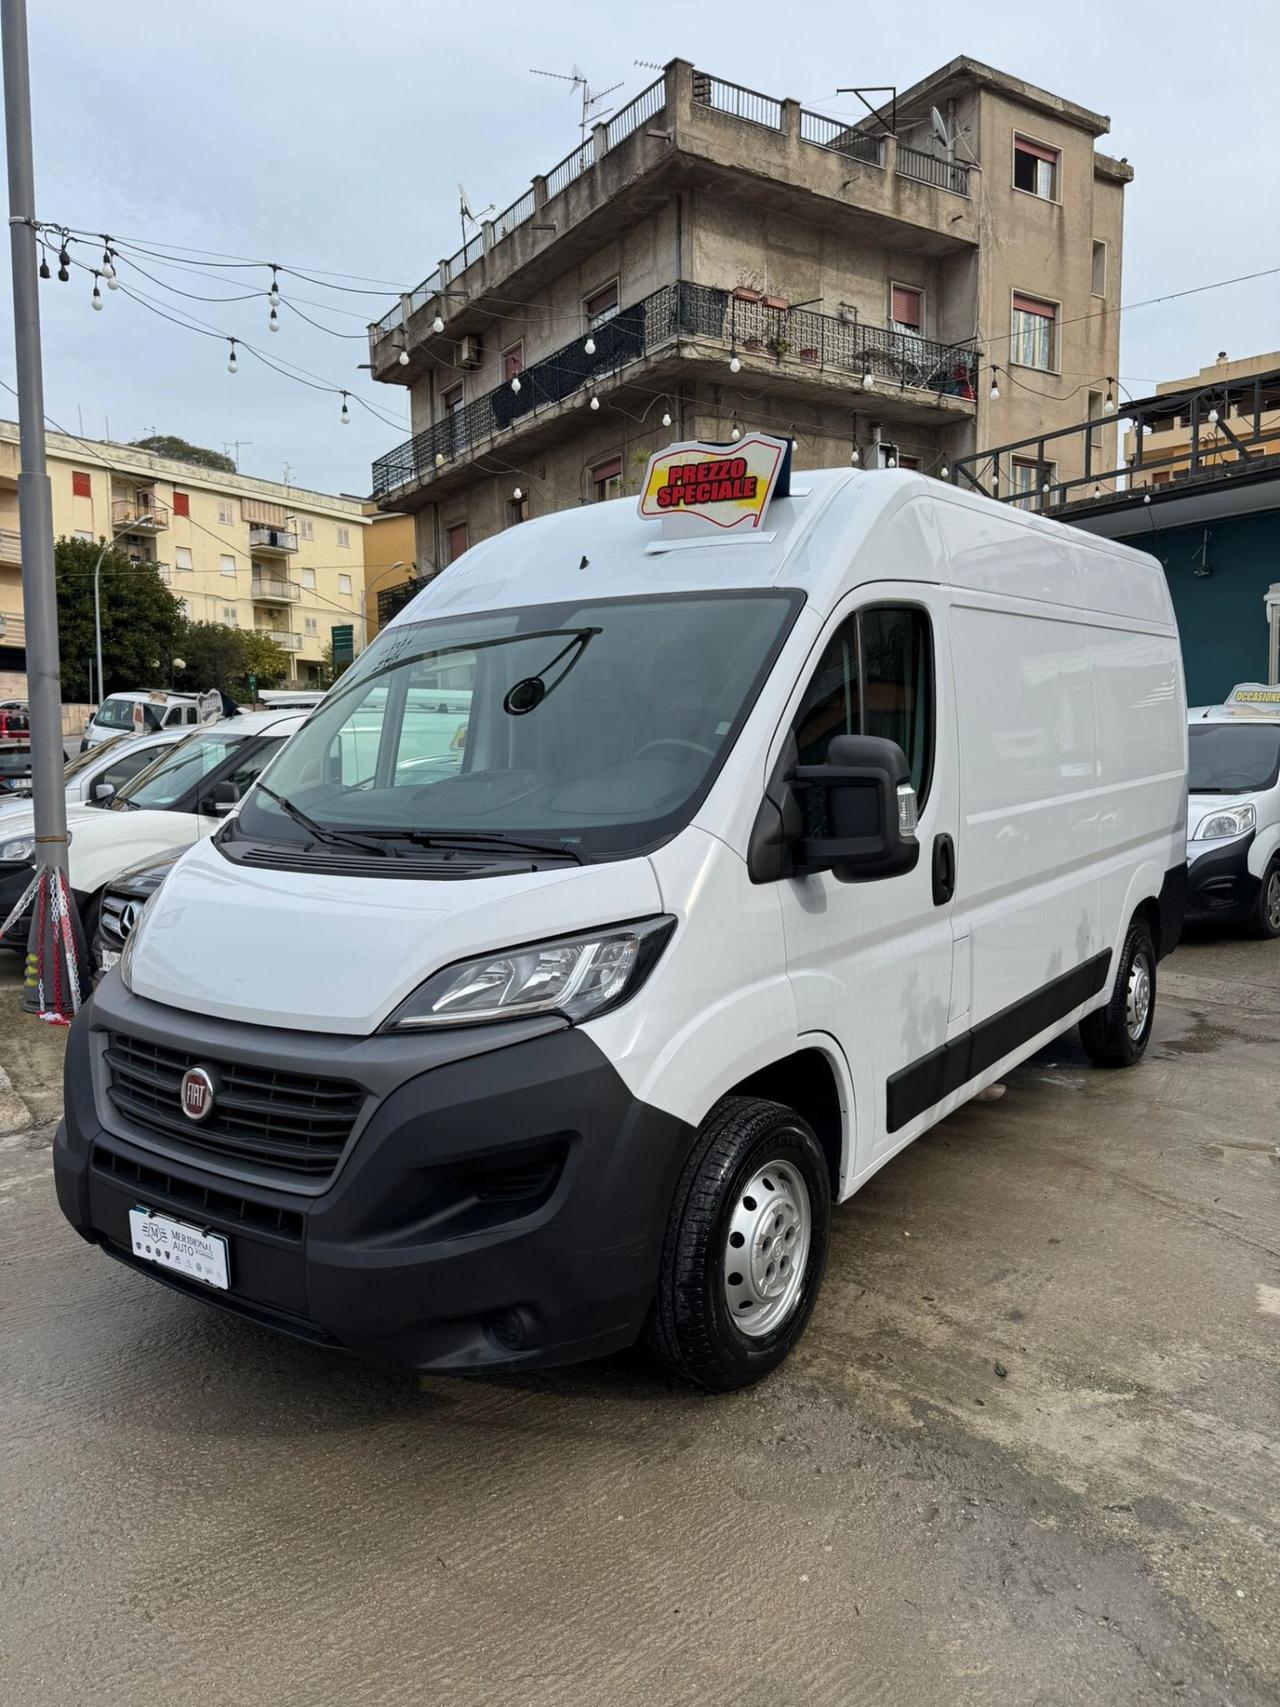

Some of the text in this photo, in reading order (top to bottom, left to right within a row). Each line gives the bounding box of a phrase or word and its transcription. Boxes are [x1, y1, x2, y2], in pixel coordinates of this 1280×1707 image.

[668, 457, 747, 486] PREZZO
[657, 476, 757, 507] SPECIALE
[186, 1082, 205, 1107] FIAT
[171, 1230, 212, 1251] MERIDIONAL
[173, 1241, 194, 1256] AUTO
